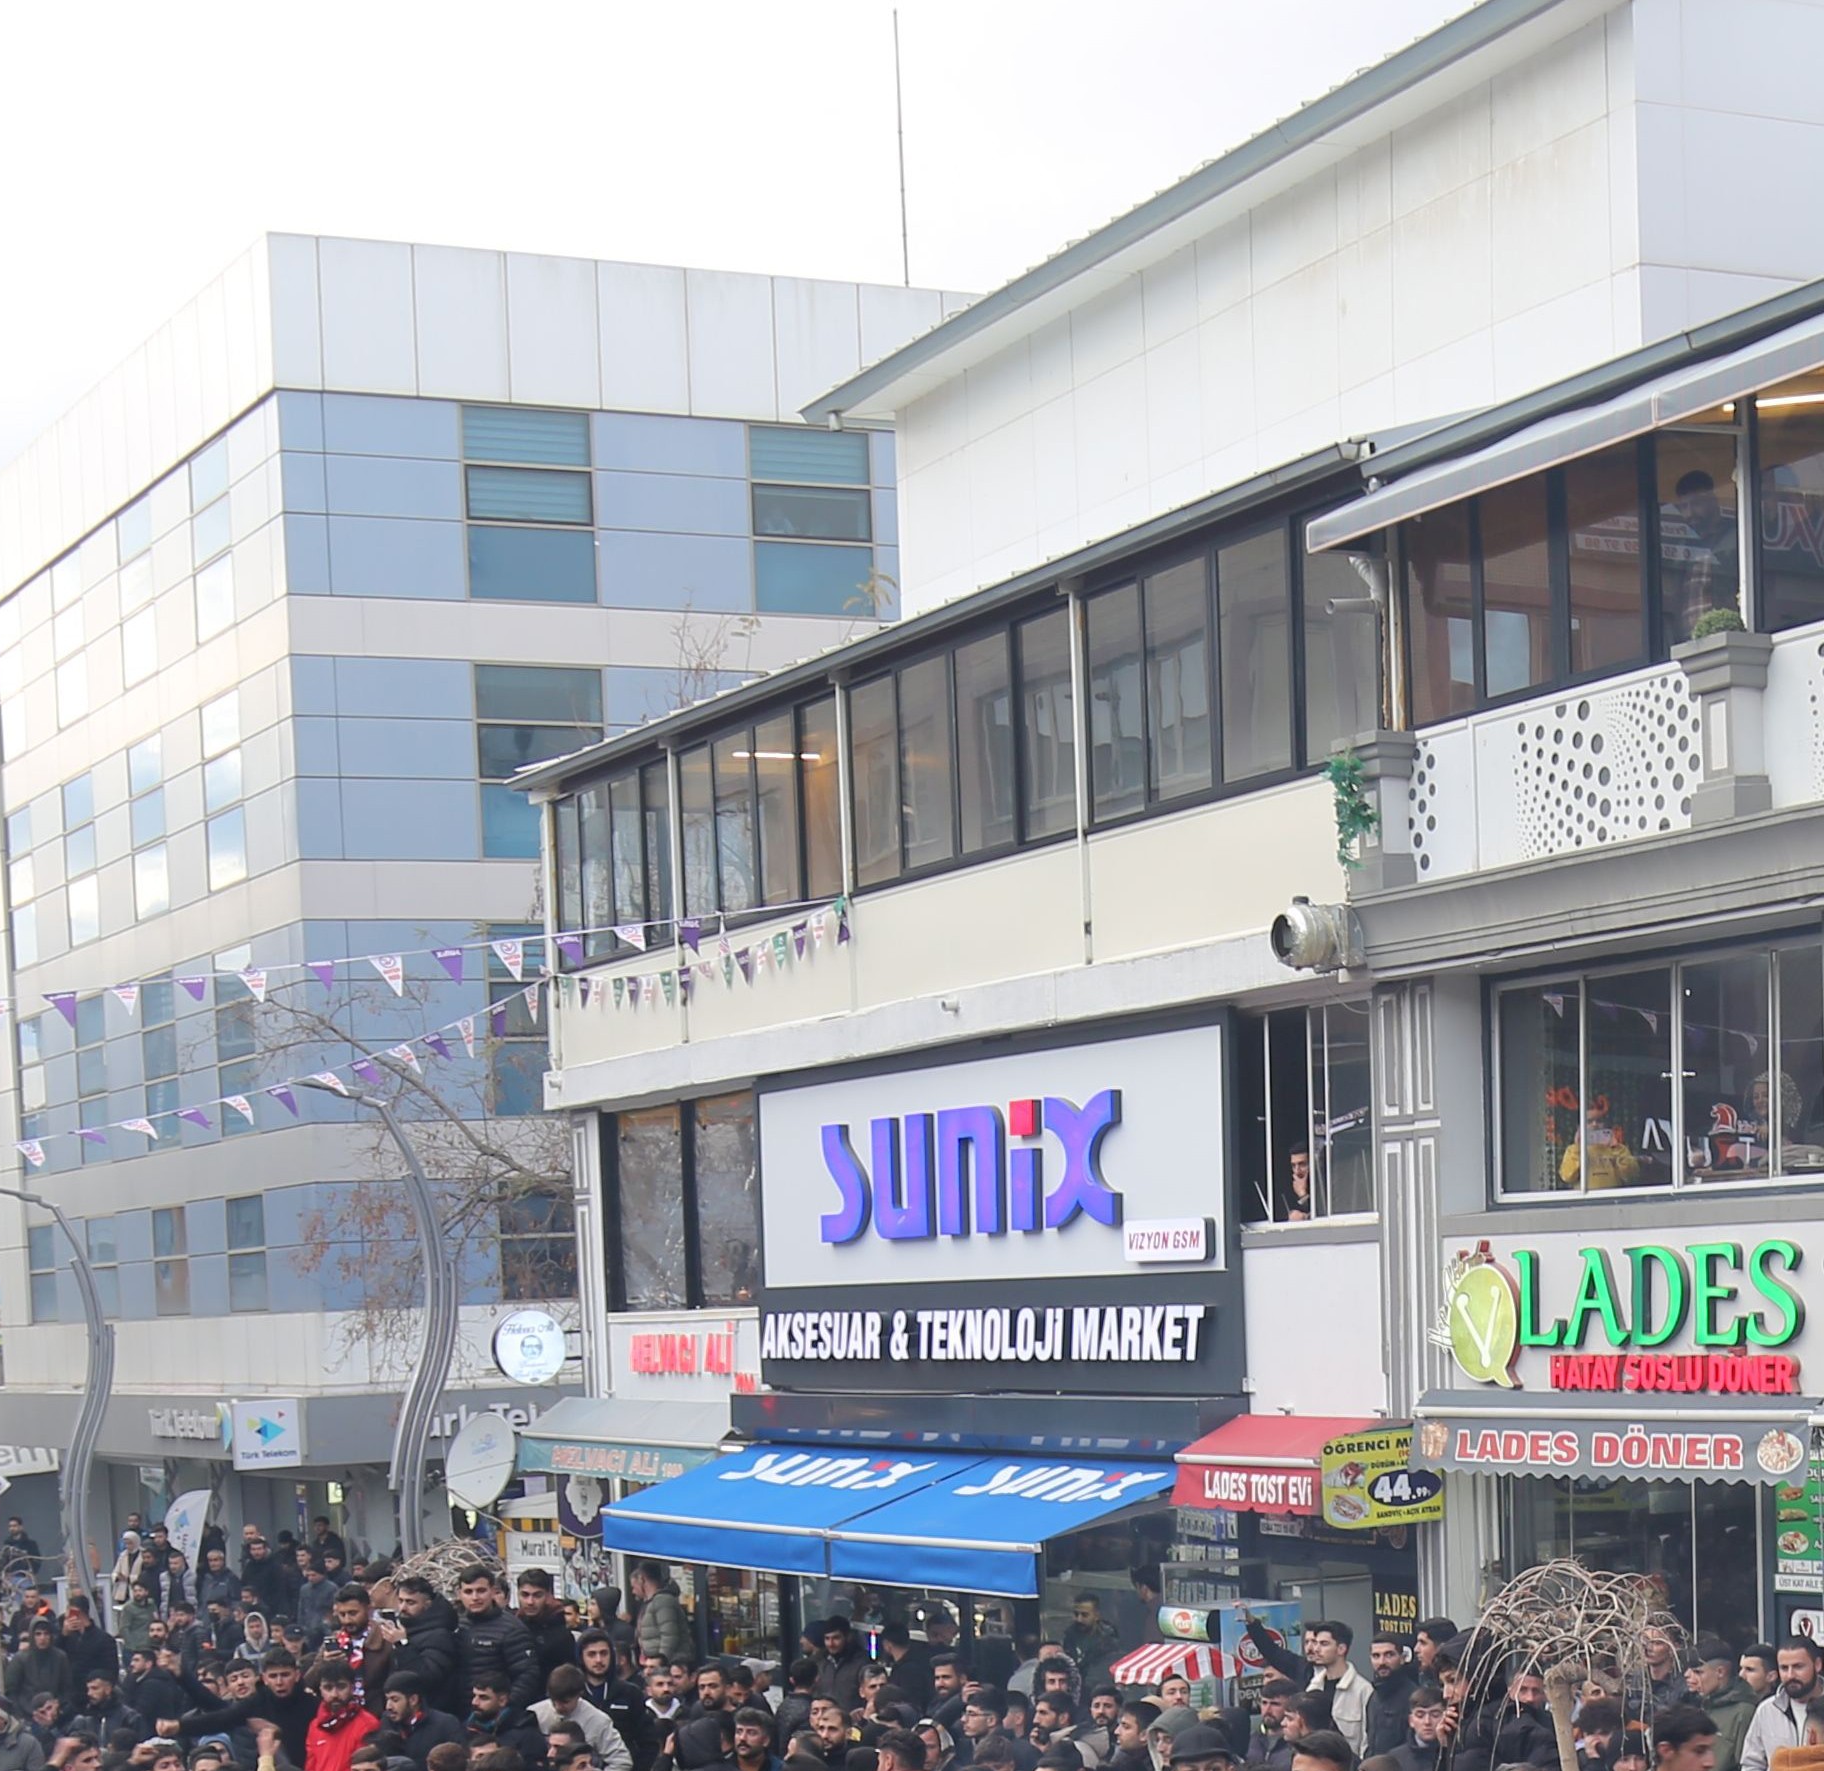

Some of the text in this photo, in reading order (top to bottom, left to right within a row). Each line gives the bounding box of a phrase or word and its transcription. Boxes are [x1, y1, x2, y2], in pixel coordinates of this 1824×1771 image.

[1172, 1227, 1201, 1250] GSM
[1511, 1238, 1804, 1348] LADES
[761, 1310, 882, 1361] AKSESUAR
[888, 1308, 910, 1362] &
[1070, 1304, 1206, 1362] MARKET
[1549, 1347, 1796, 1394] HATAY SOSLU DÖNER
[240, 1449, 297, 1460] Türk Telekom
[1455, 1424, 1744, 1471] LADES DÖNER
[1204, 1469, 1247, 1502] LADES
[1250, 1473, 1286, 1506] TOST
[521, 1538, 547, 1558] Murat
[1375, 1590, 1418, 1620] LADES
[1378, 1618, 1399, 1635] TOST
